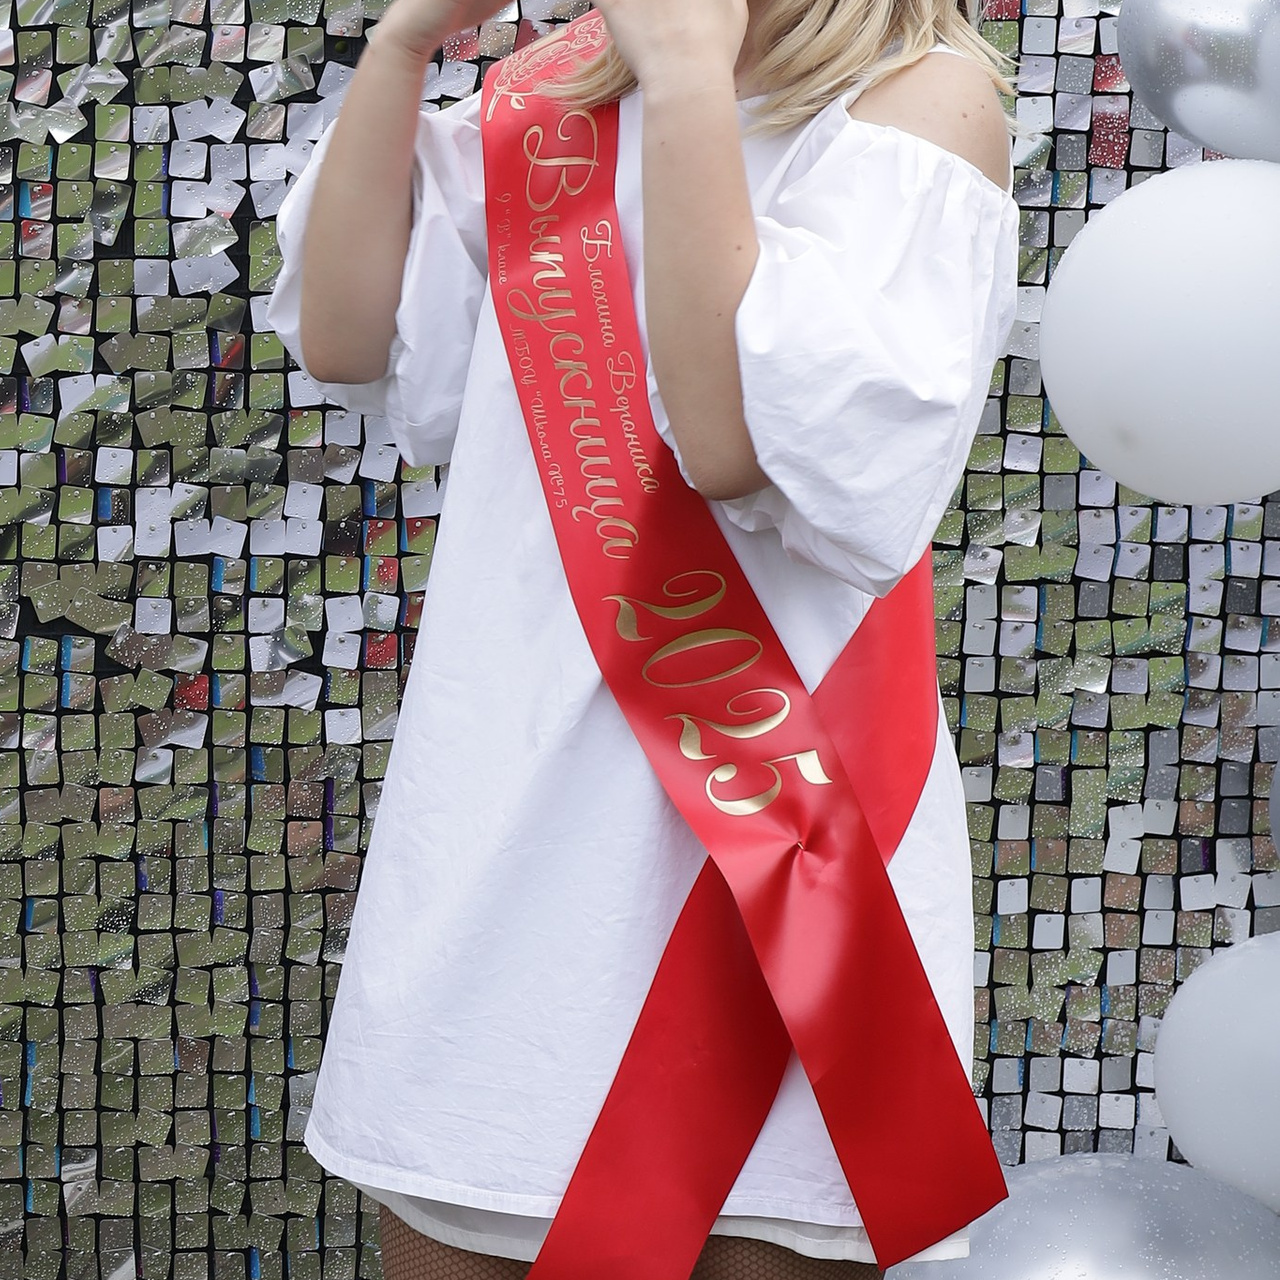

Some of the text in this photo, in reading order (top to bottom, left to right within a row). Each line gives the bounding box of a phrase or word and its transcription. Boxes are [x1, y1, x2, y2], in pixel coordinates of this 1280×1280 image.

[496, 243, 511, 286] класс
[581, 219, 660, 494] Блохина Вероника
[506, 108, 832, 817] Выпускница 2025
